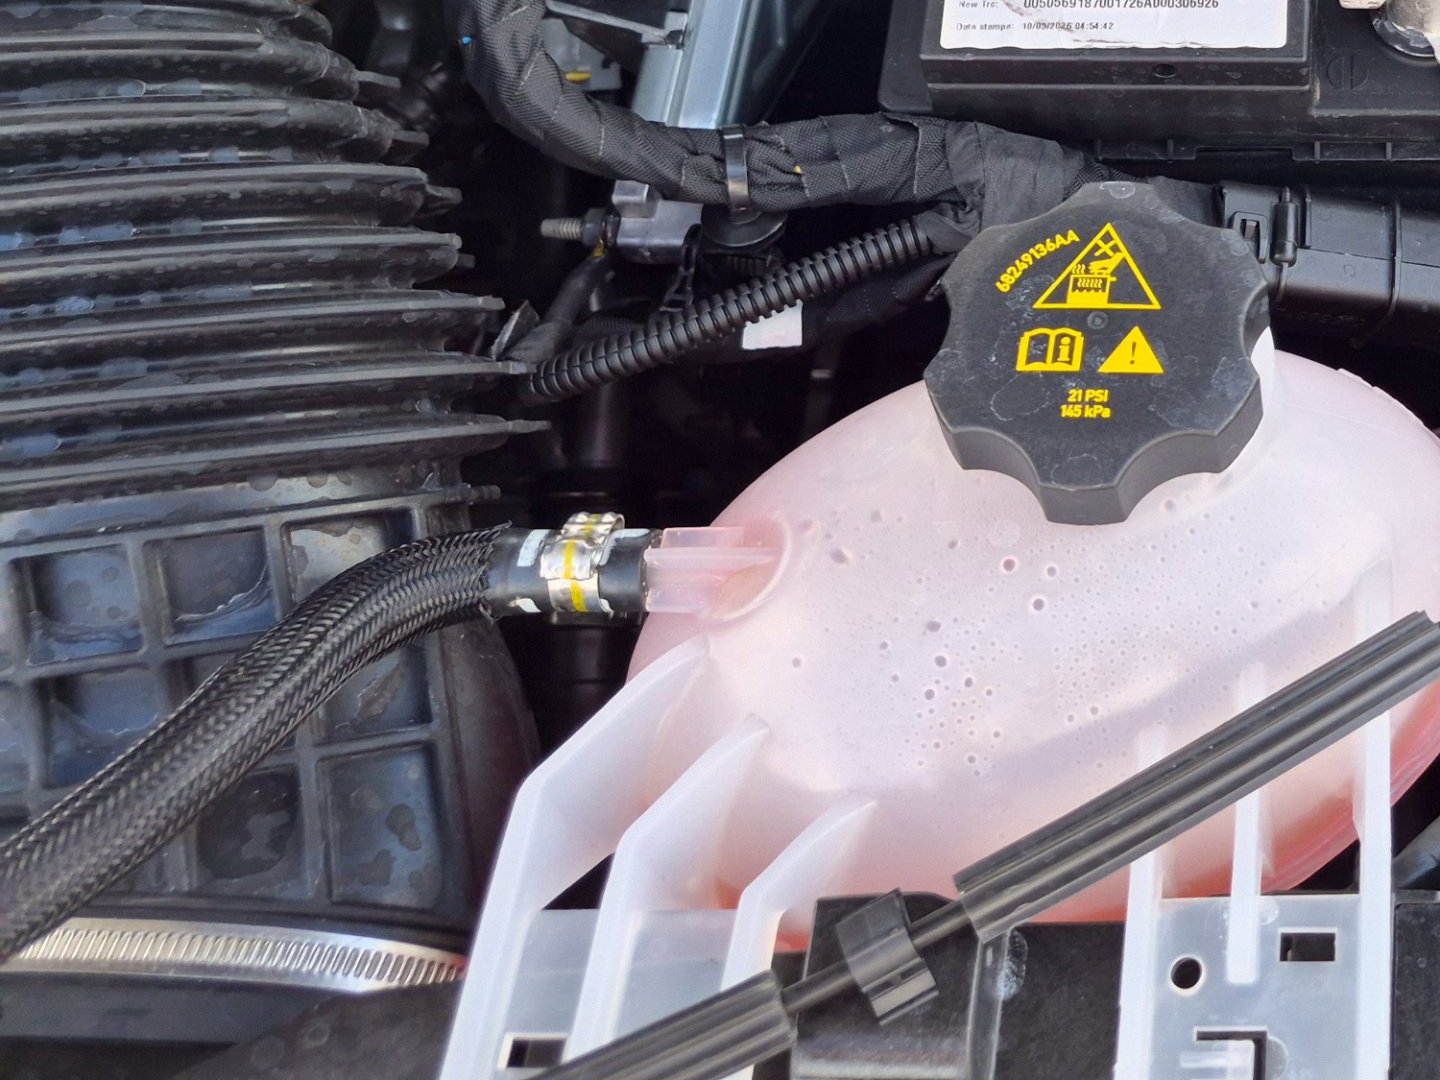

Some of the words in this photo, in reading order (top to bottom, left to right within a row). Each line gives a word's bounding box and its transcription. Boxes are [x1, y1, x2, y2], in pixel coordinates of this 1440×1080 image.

[995, 229, 1081, 293] 68249136AA
[1067, 389, 1082, 402] 21
[1085, 389, 1108, 402] PSI
[1060, 405, 1081, 418] 145
[1084, 405, 1111, 418] kPa
